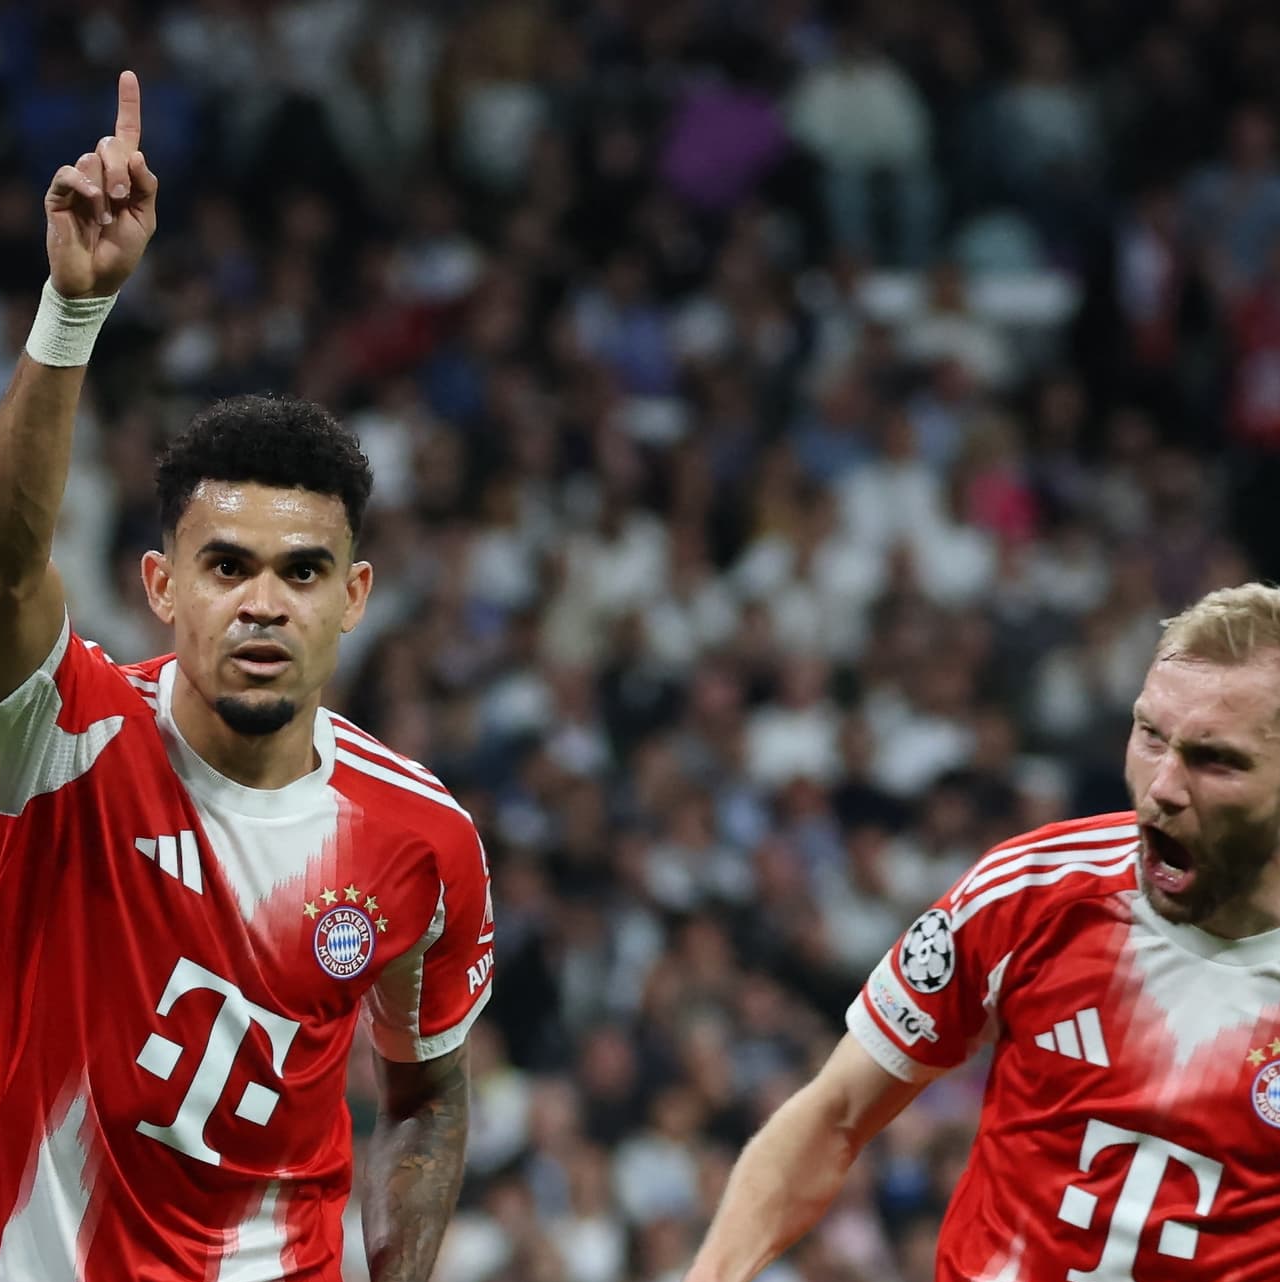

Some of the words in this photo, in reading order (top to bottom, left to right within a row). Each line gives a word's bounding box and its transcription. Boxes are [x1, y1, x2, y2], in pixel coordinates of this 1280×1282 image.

[321, 918, 334, 934] FC
[335, 912, 369, 942] BAYERN
[136, 956, 300, 1166] T
[1262, 1067, 1278, 1082] FC
